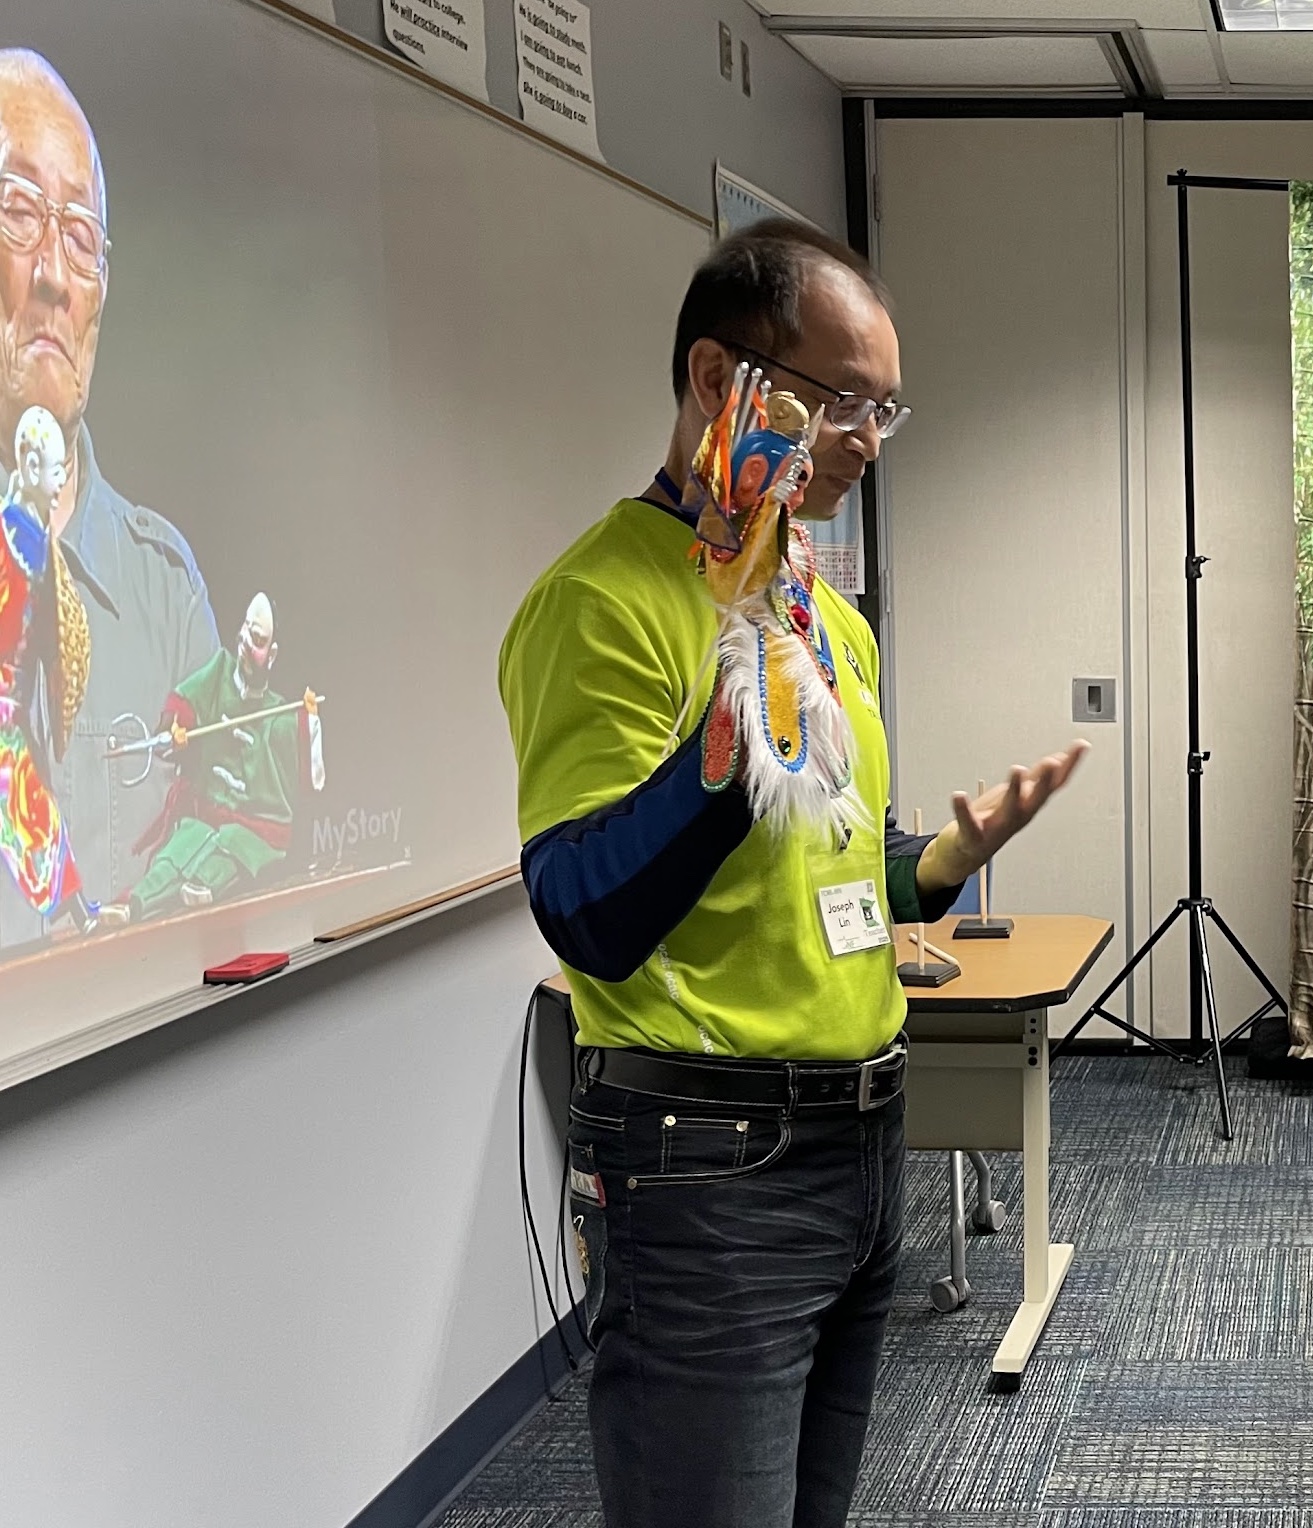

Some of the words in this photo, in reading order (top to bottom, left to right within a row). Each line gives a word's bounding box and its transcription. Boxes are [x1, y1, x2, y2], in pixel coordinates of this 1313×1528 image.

[400, 5, 413, 23] will
[413, 13, 440, 38] practice
[532, 12, 549, 34] going
[555, 4, 569, 23] going
[524, 35, 533, 47] am
[533, 40, 549, 60] going
[556, 54, 566, 68] eat
[545, 71, 559, 89] going
[539, 92, 555, 111] going
[562, 101, 573, 120] buy
[312, 807, 402, 860] MyStory
[828, 899, 855, 914] Joseph
[838, 916, 851, 928] Lin
